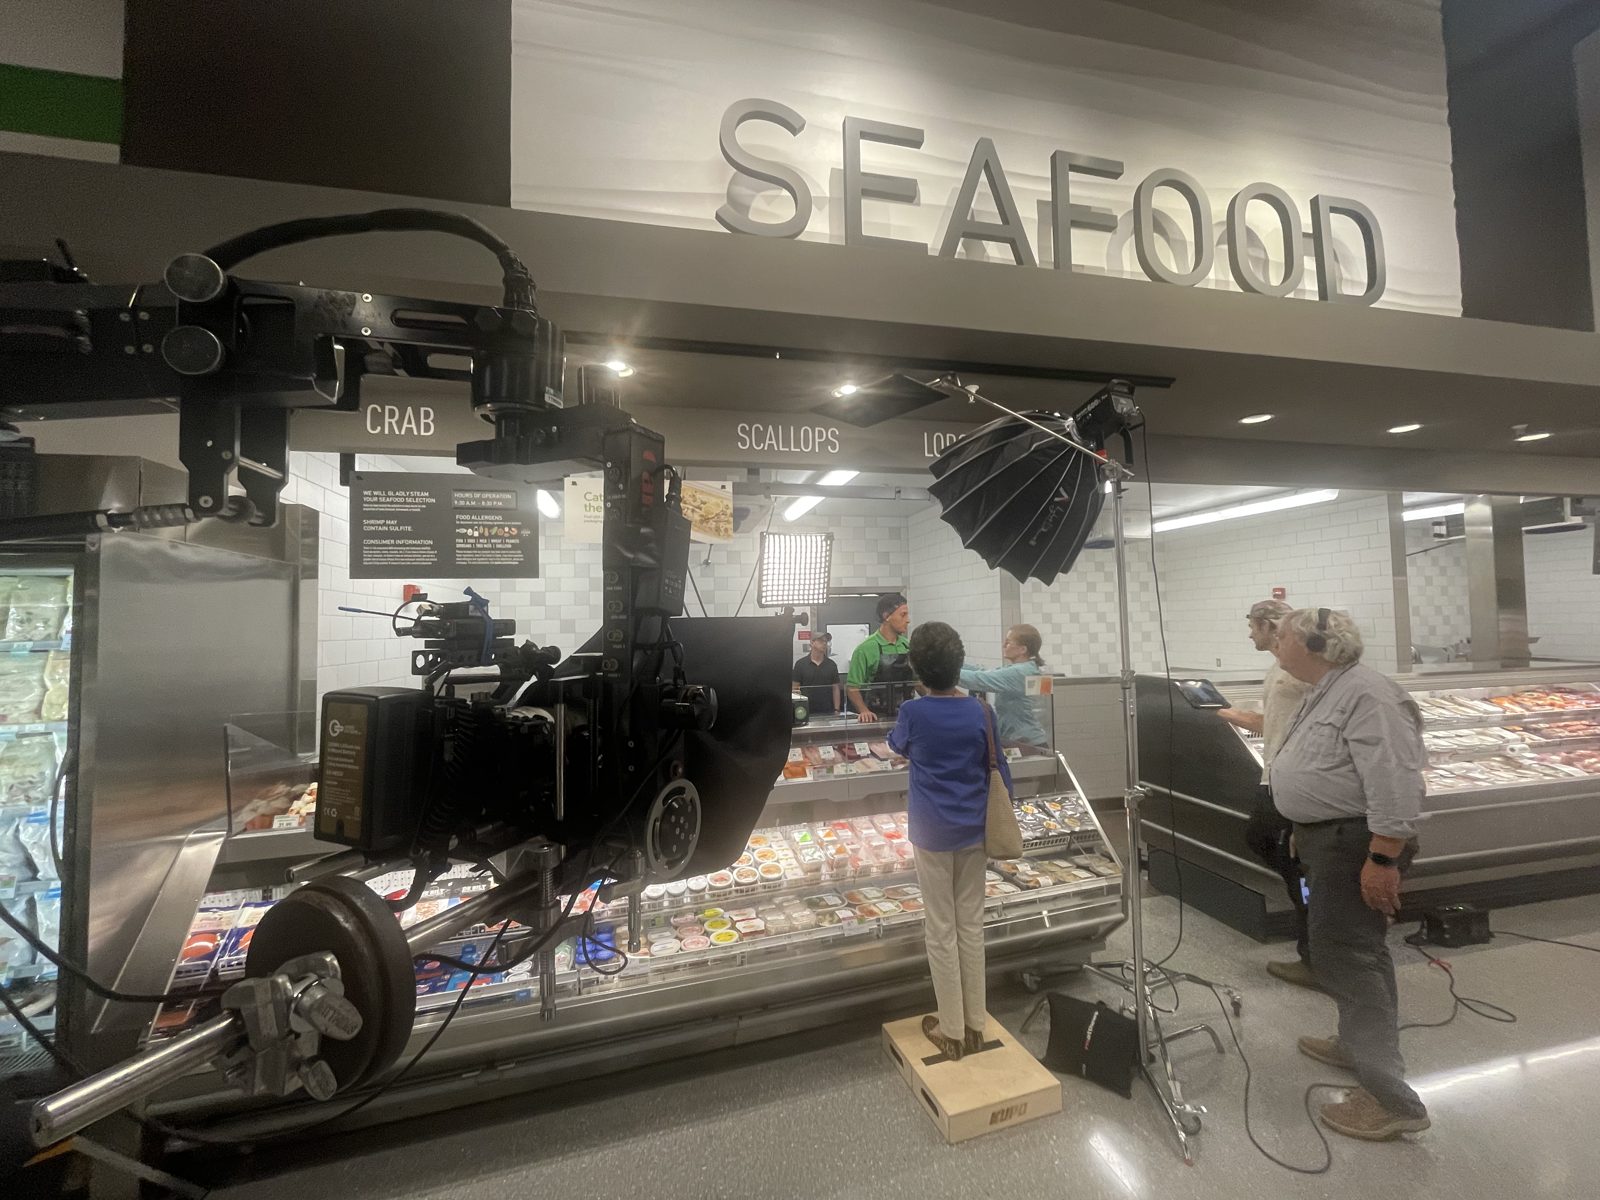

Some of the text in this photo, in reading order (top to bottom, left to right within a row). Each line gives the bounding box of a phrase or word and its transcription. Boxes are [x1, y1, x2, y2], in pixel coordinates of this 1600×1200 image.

[714, 97, 1387, 307] SEAFOOD
[366, 404, 435, 437] CRAB
[737, 424, 840, 454] SCALLOPS
[584, 491, 604, 502] Cat
[584, 503, 602, 512] the
